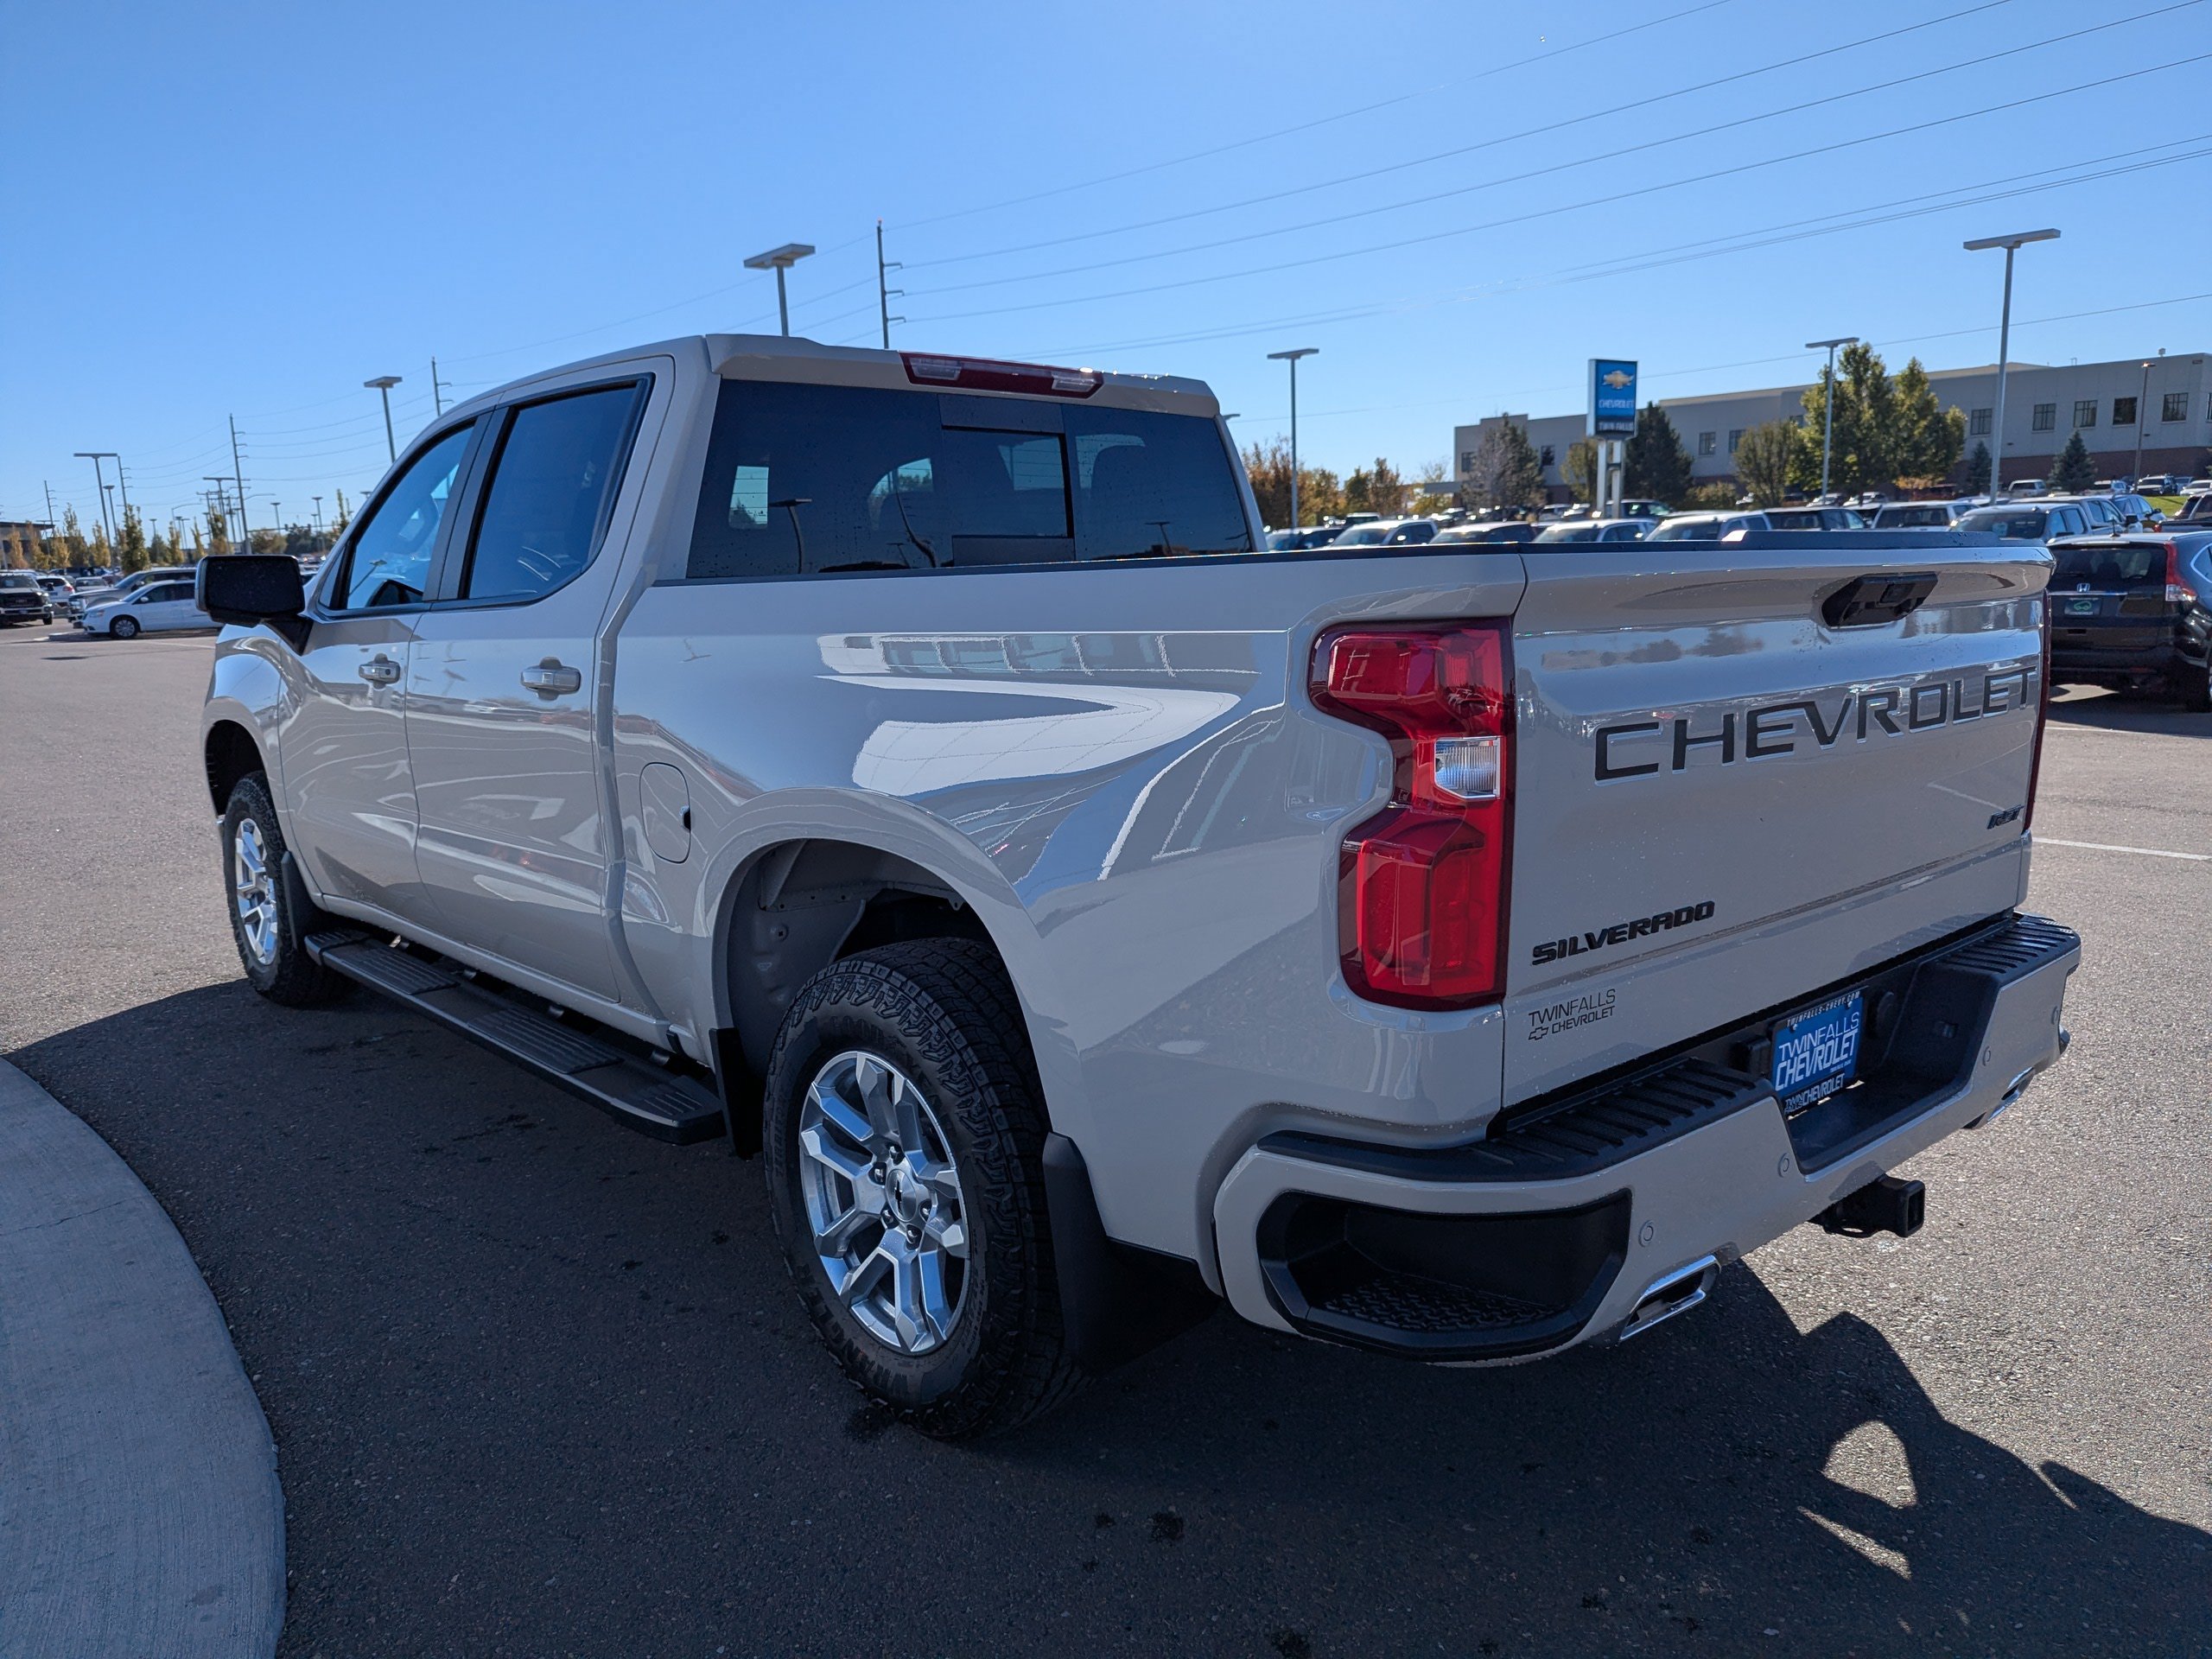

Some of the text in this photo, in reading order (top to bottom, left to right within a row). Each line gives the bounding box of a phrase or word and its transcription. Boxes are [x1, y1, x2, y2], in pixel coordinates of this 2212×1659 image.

[1594, 665, 2037, 783] CHEVROLET
[1531, 900, 1716, 966] SILVERADO
[1551, 1006, 1616, 1034] CHEVROLET
[1775, 1027, 1859, 1092] CHEVROLET
[1802, 1072, 1846, 1107] CHEVROLET
